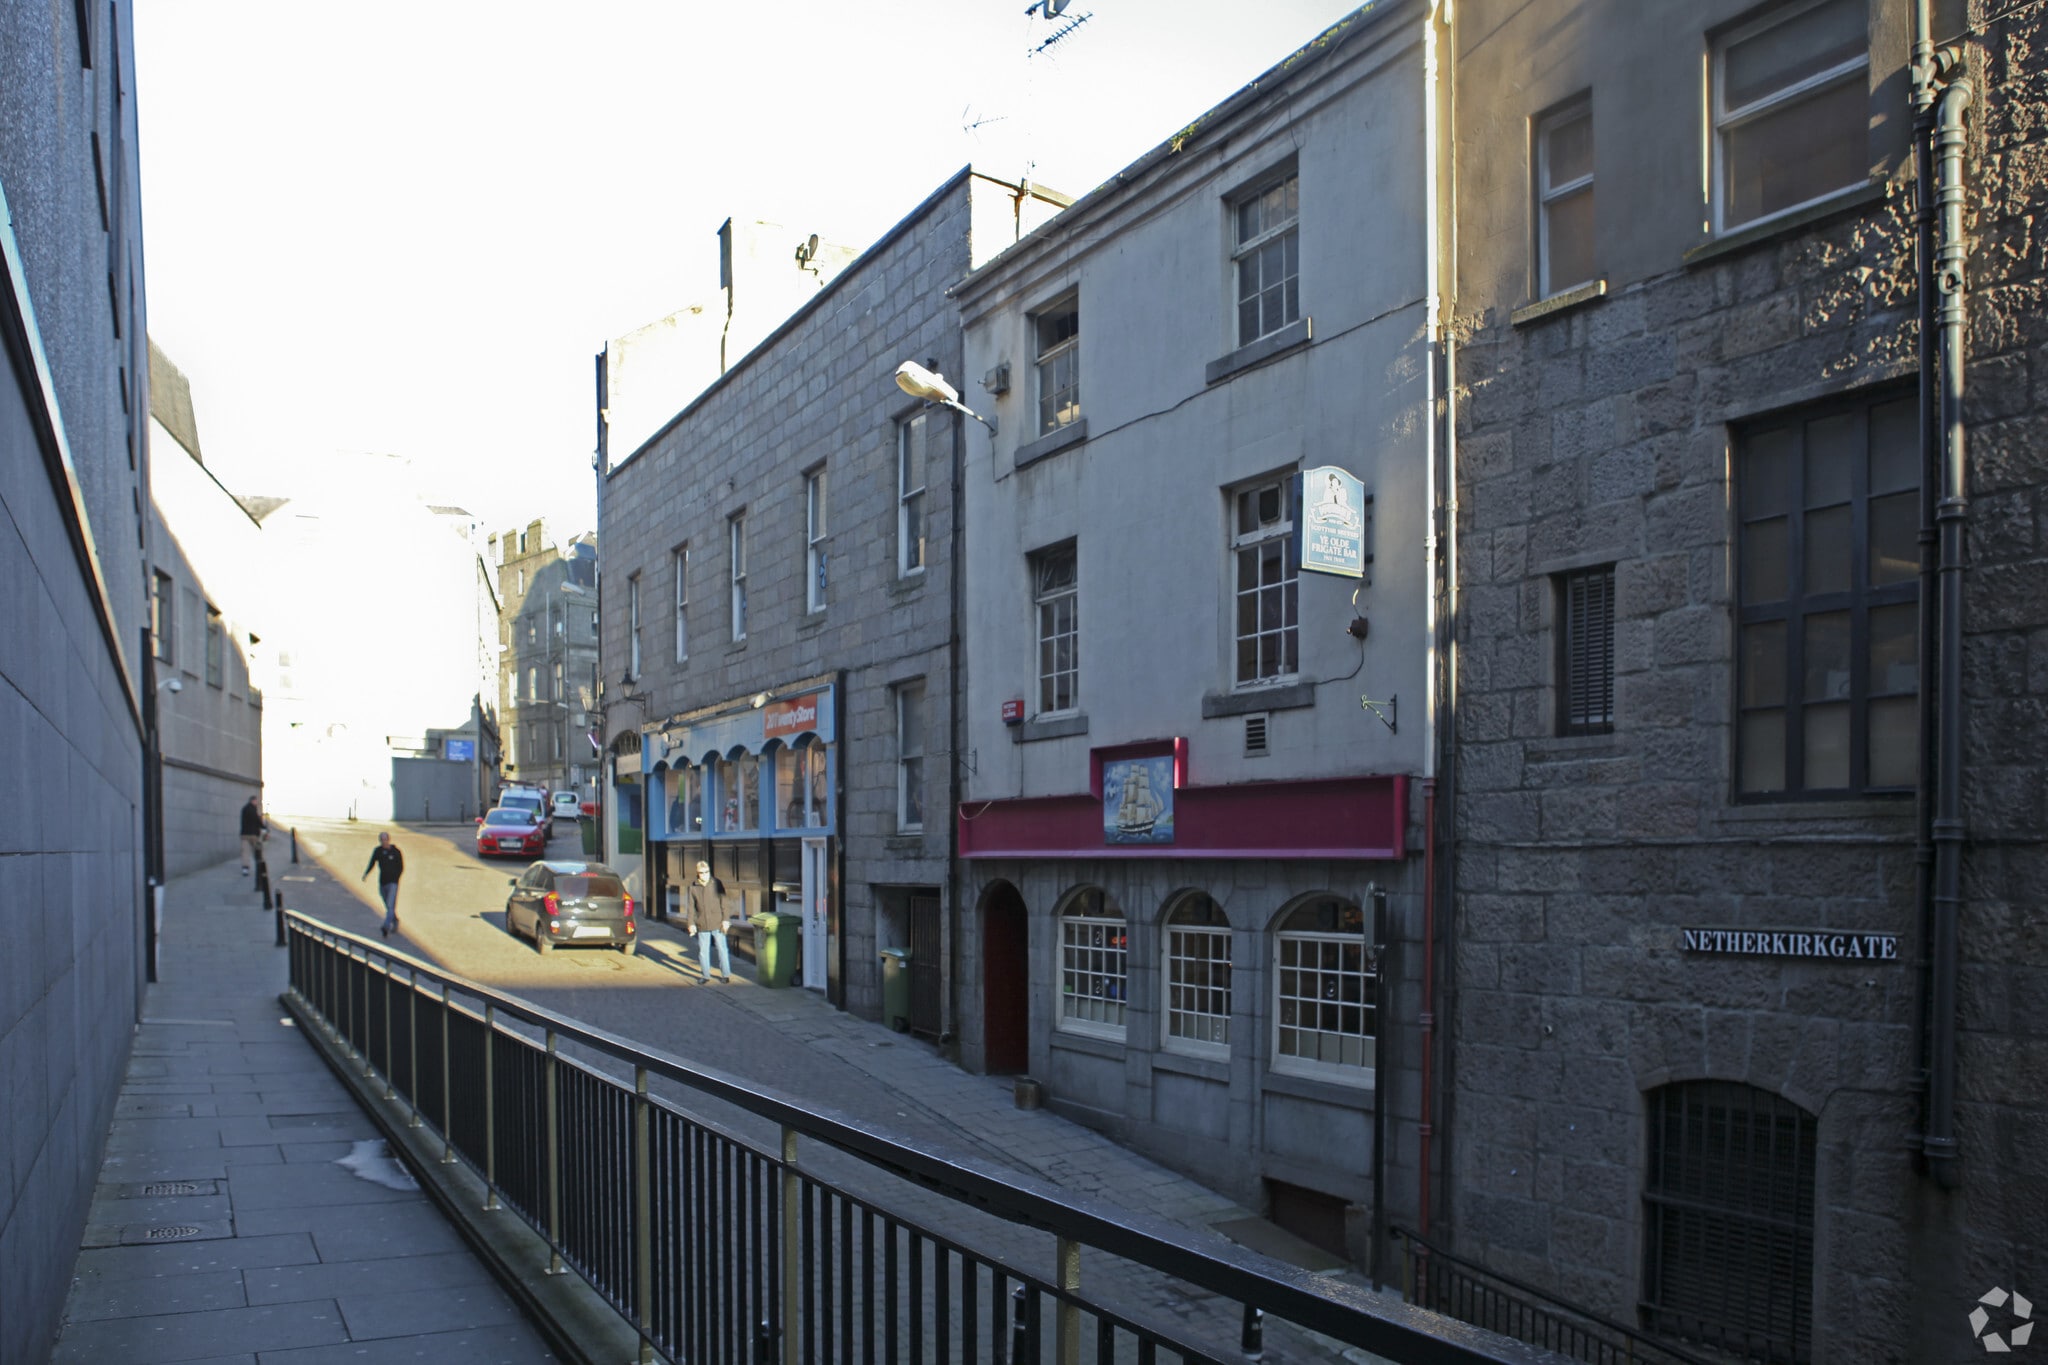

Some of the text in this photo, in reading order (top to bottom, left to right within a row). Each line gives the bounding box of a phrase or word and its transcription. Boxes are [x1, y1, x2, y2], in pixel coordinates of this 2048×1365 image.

[1312, 542, 1342, 556] FRIGATE
[1343, 548, 1357, 559] BAR
[1320, 535, 1349, 549] YE OLDE
[1683, 930, 1897, 960] NETHERKIRKGATE
